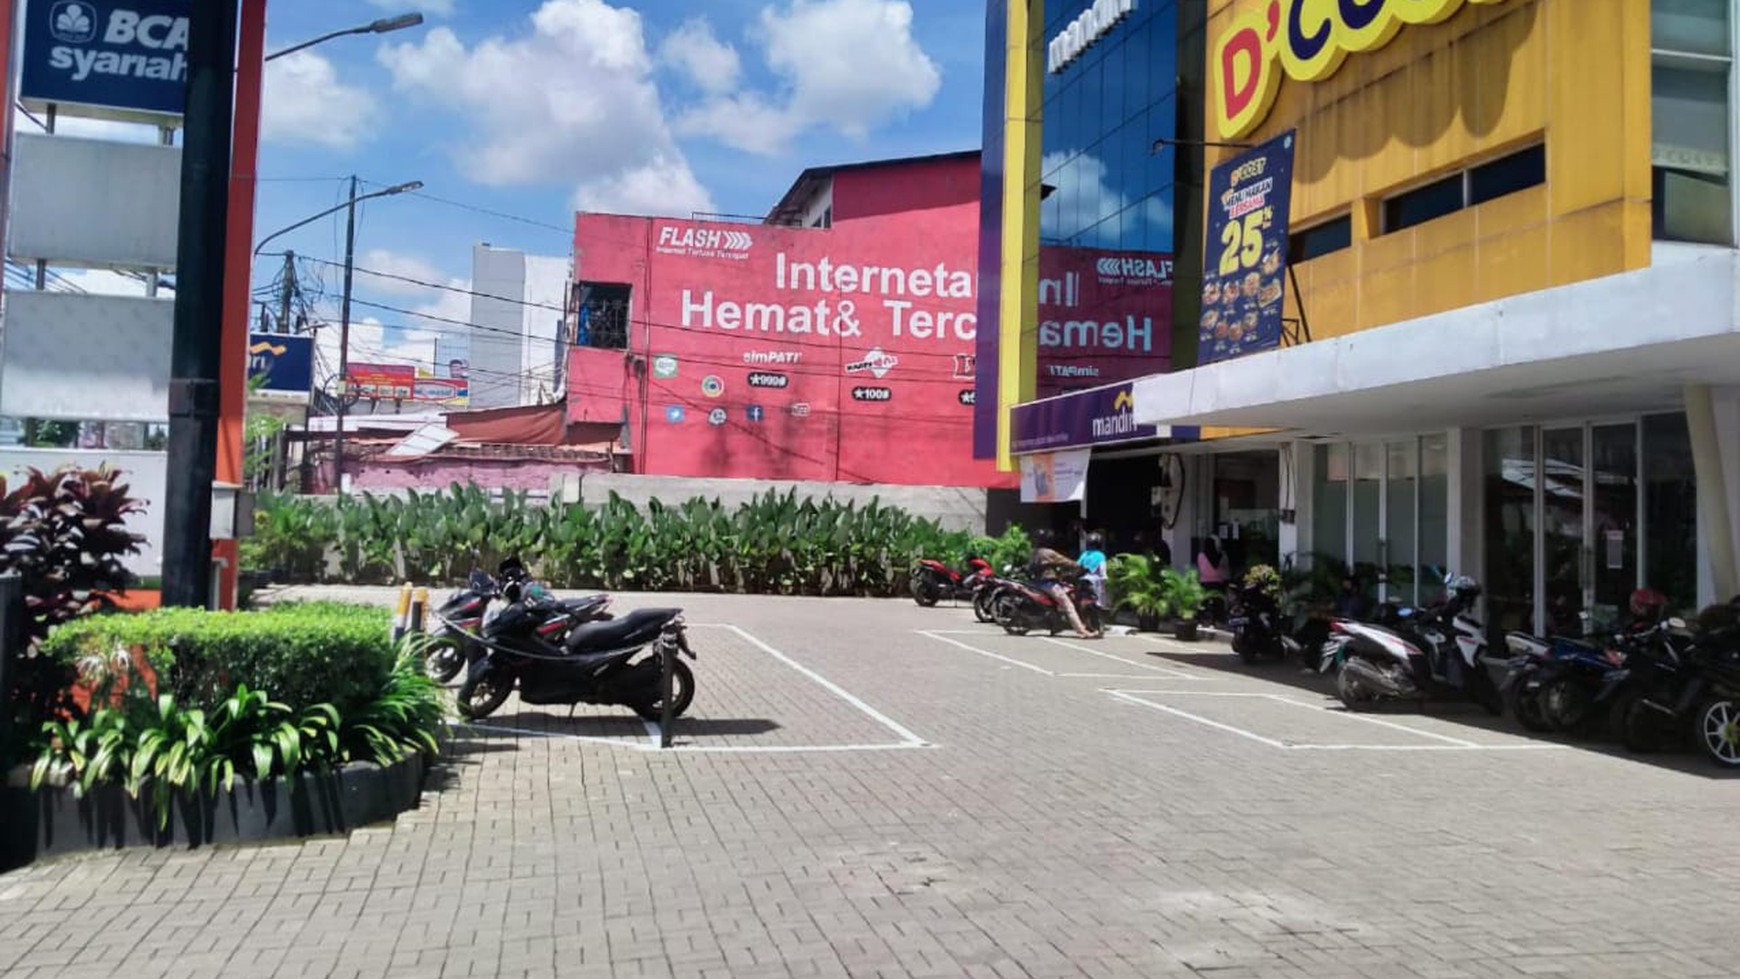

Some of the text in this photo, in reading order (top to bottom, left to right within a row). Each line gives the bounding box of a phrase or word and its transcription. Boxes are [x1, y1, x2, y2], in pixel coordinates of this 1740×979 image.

[103, 9, 190, 51] BCA
[660, 226, 721, 248] FLASH
[777, 253, 973, 297] Interneta
